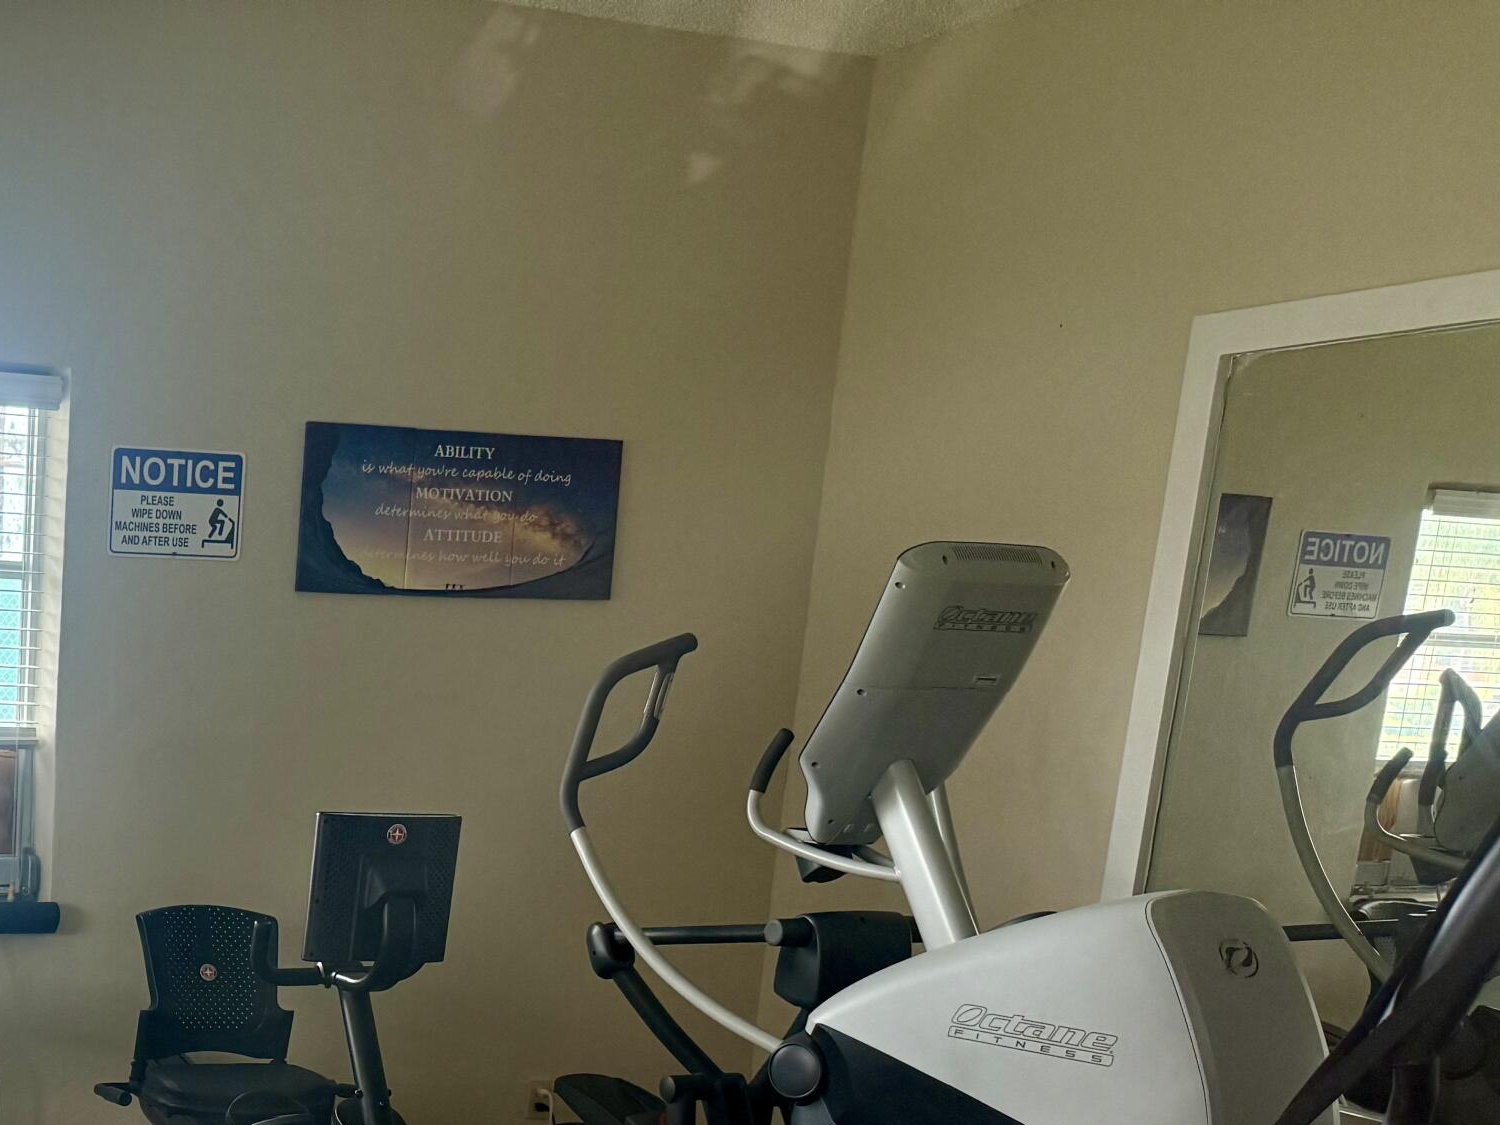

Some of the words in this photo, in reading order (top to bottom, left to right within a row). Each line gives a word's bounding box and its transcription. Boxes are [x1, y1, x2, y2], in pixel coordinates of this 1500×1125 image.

[434, 444, 495, 460] ABILITY
[120, 456, 236, 490] NOTICE
[378, 461, 415, 476] what
[462, 467, 516, 483] capable
[517, 469, 532, 486] of
[534, 470, 572, 487] doing
[140, 495, 174, 507] PLEASE
[415, 487, 513, 503] MOTIVATION
[132, 508, 153, 519] WIPE
[155, 509, 182, 520] DOWN
[374, 503, 451, 520] determines
[115, 521, 160, 533] MACHINES
[162, 523, 197, 534] BEFORE
[121, 535, 141, 545] AND
[141, 536, 170, 546] AFTER
[172, 538, 189, 547] USE
[423, 528, 503, 544] ATTITUDE
[951, 1003, 1119, 1052] Octane
[954, 1029, 1103, 1063] FITNESS
